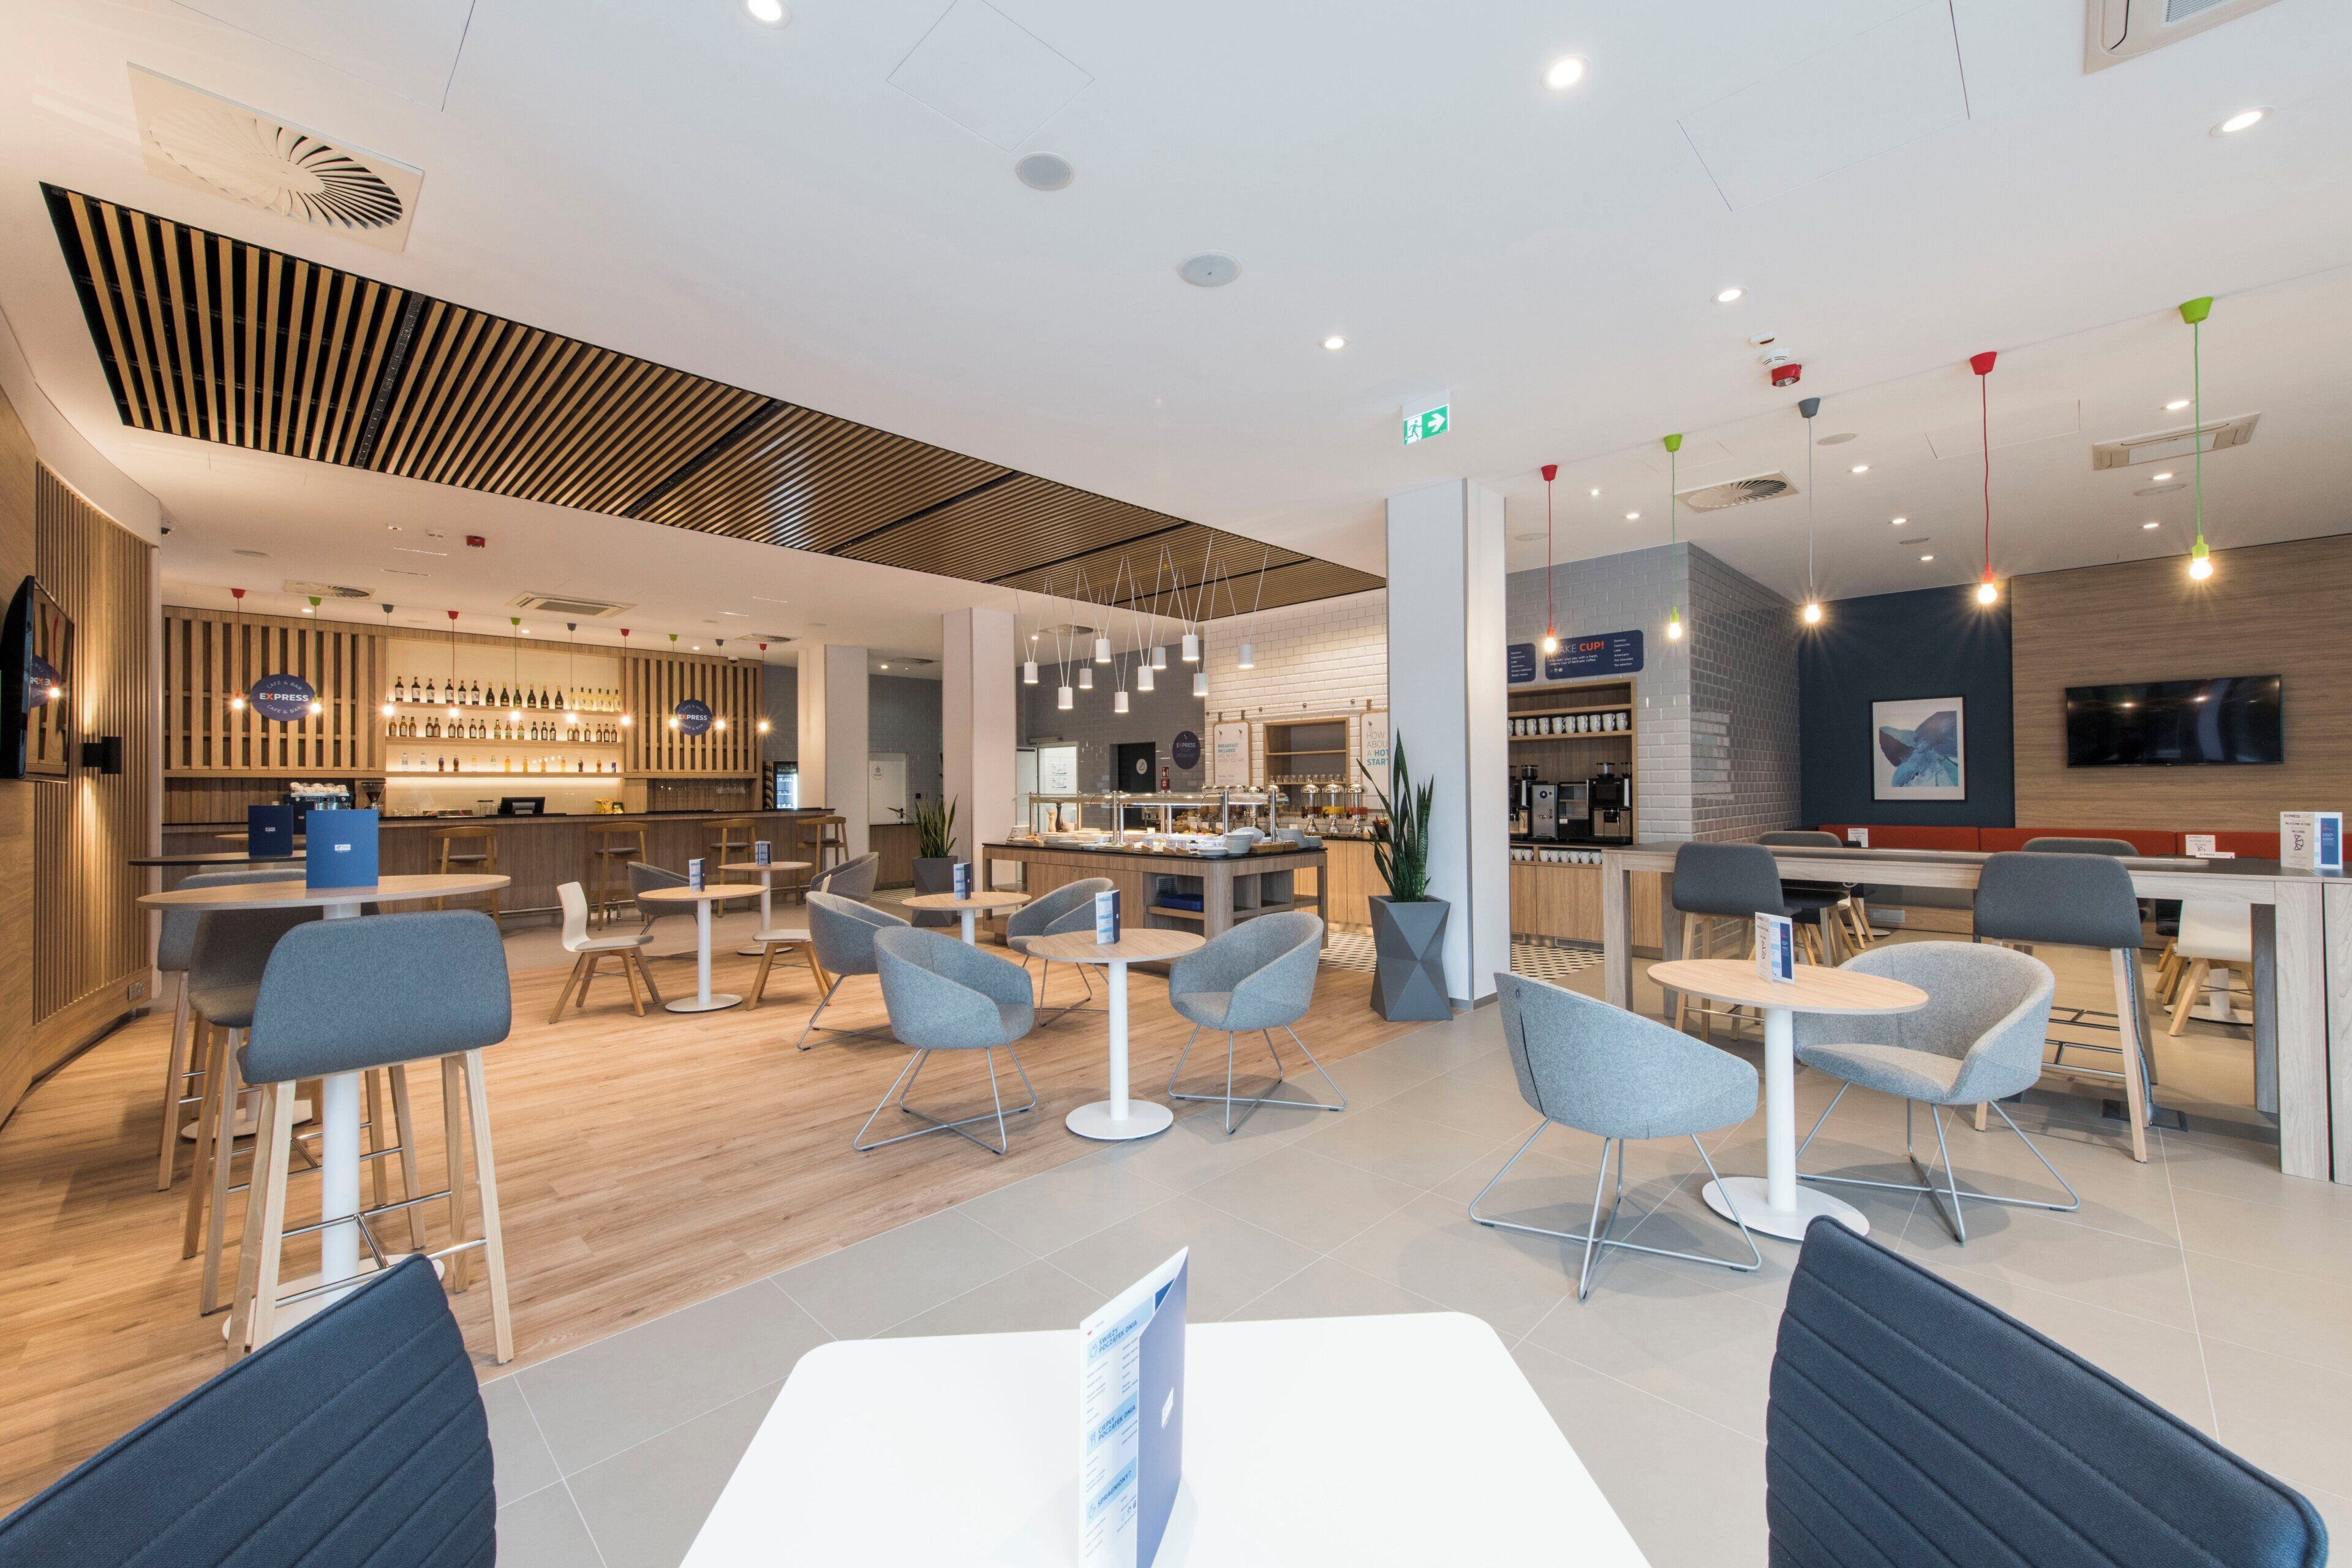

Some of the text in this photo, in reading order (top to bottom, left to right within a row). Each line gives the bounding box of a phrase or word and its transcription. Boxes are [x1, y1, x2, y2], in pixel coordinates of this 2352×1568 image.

[1579, 640, 1604, 652] CUP!
[290, 682, 303, 690] BAR
[260, 693, 309, 701] EXPRESS
[1125, 1319, 1137, 1333] DNIA
[1125, 1404, 1136, 1419] DNIA
[1098, 1470, 1131, 1507] SPRAGNIONY?
